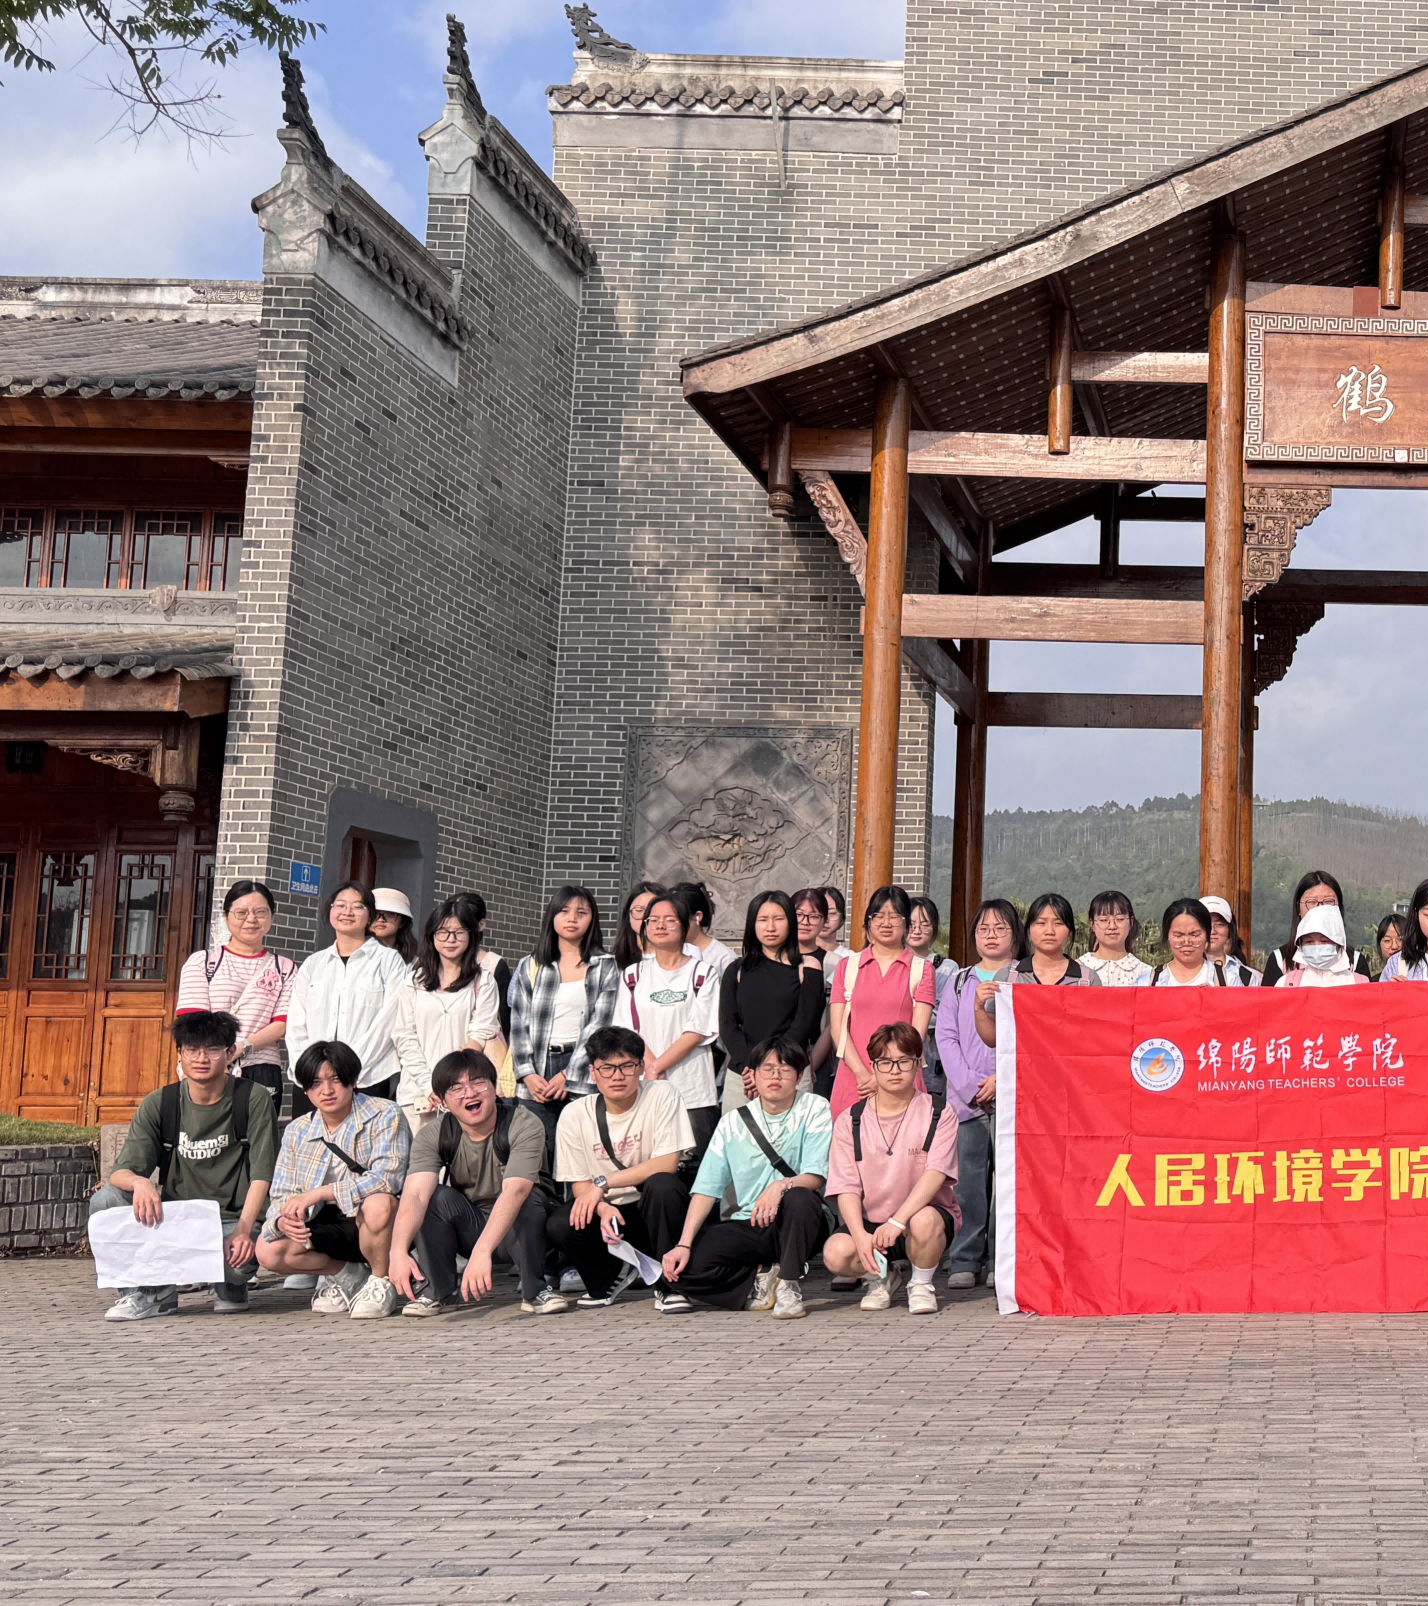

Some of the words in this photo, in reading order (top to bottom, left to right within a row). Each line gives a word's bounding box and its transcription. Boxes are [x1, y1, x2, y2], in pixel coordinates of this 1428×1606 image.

[1198, 1079, 1265, 1091] MIANYANG
[1268, 1077, 1340, 1090] TEACHERS'
[1346, 1076, 1405, 1088] COLLEGE
